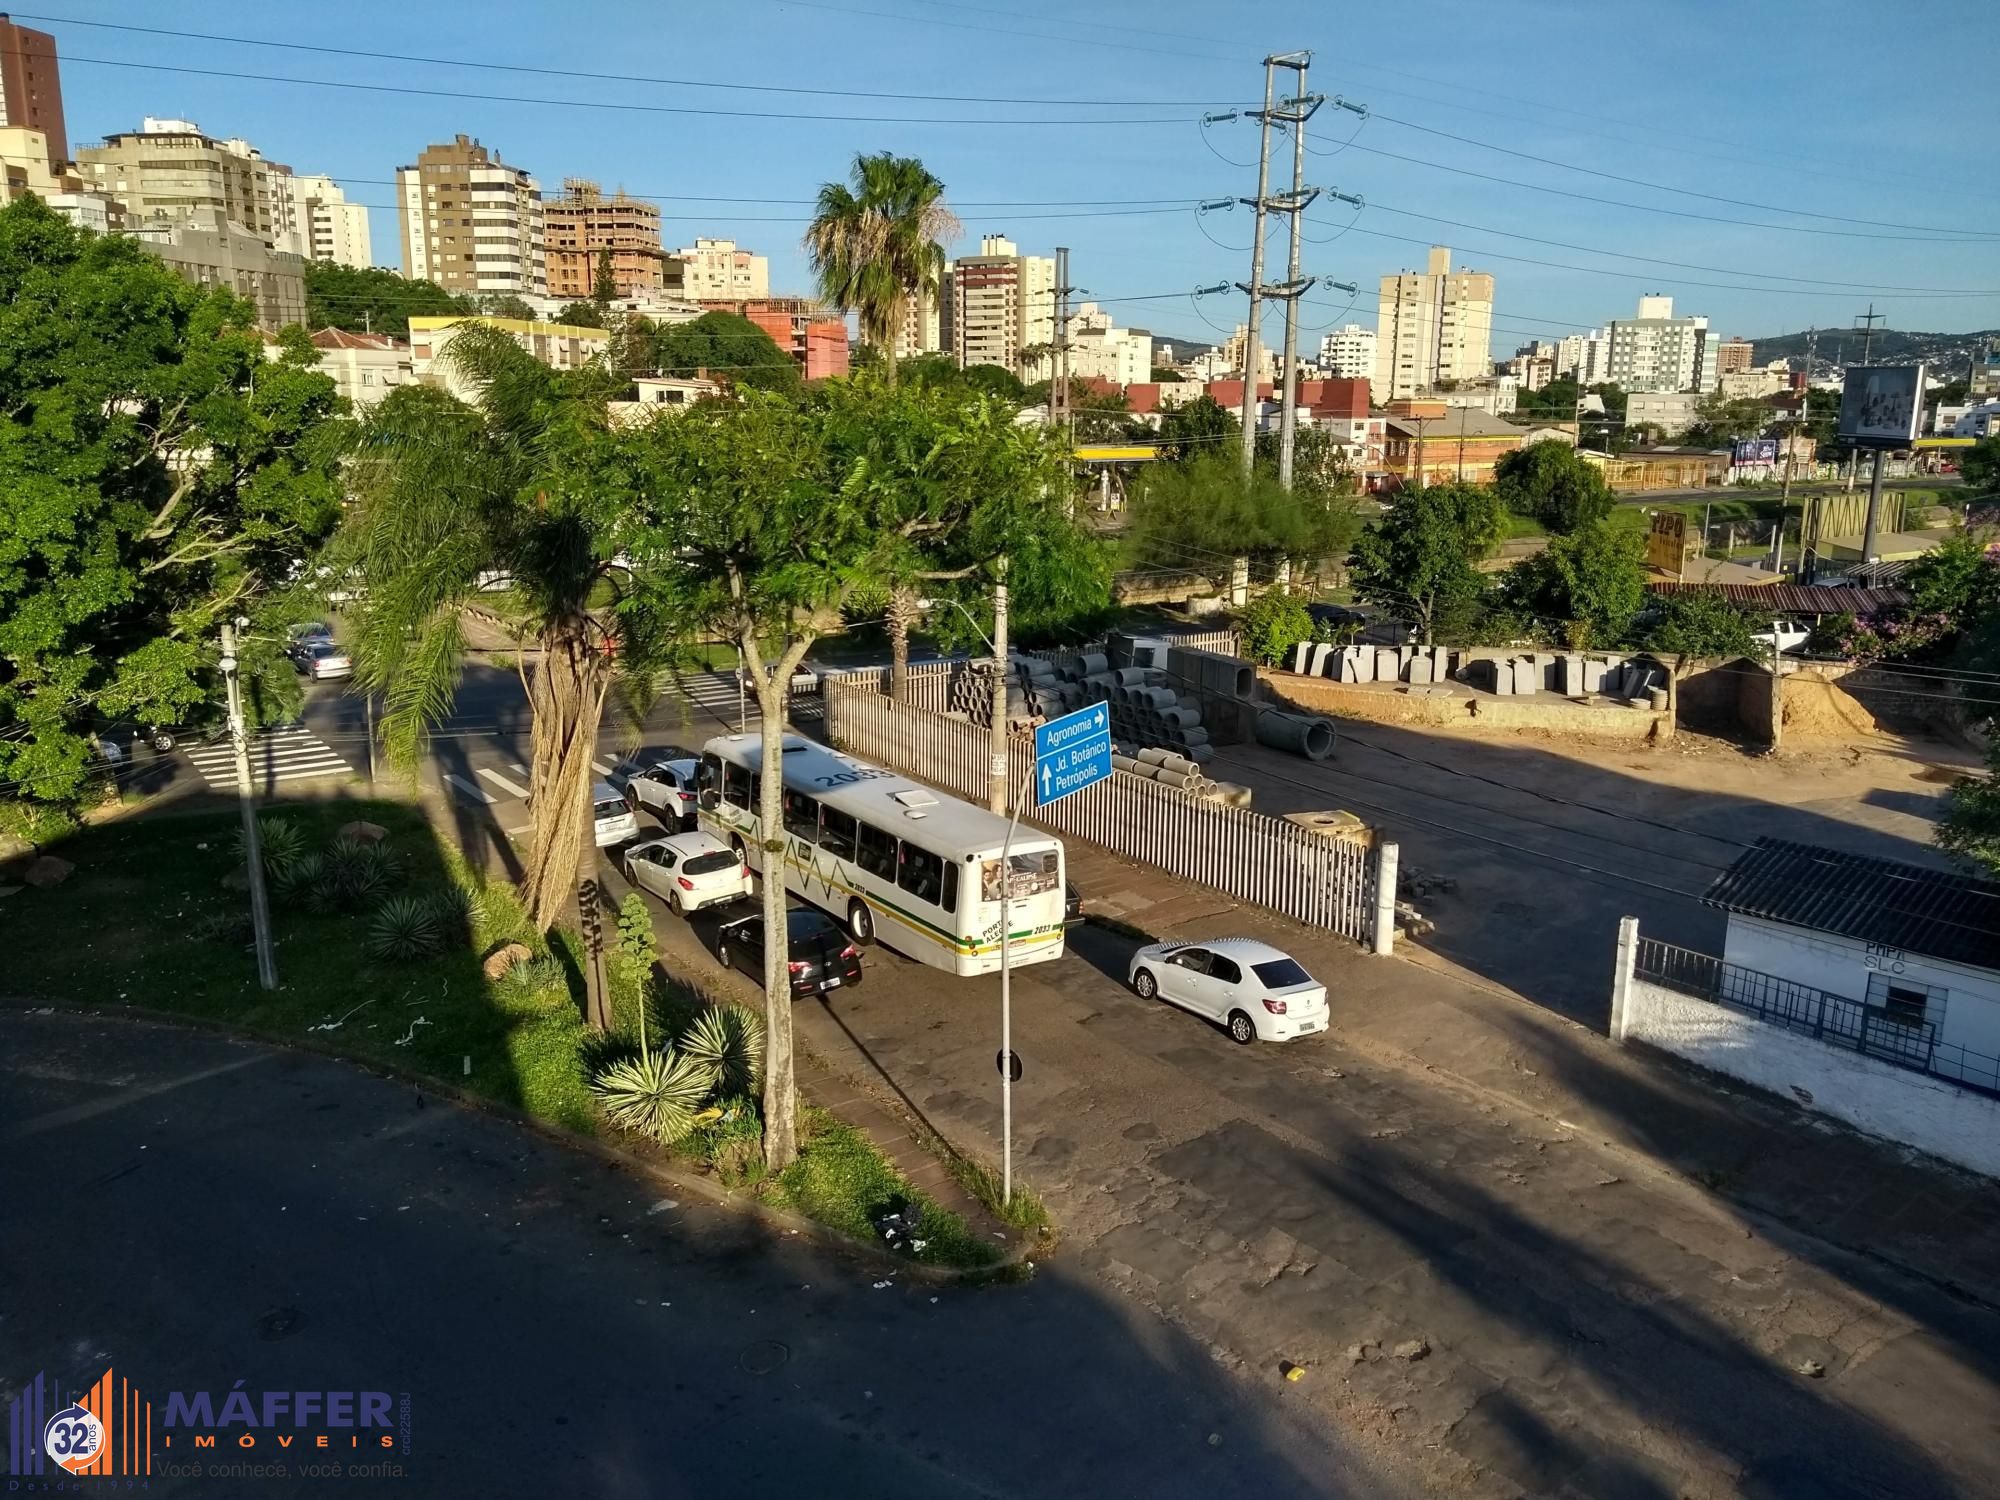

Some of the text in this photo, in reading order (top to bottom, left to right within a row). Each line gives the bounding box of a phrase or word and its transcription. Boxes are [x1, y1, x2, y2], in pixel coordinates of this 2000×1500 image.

[1047, 717, 1092, 747] Agronomia
[1055, 741, 1107, 773] Jd. Botânico
[814, 768, 897, 787] 2033
[1056, 763, 1098, 791] Petrópolis
[1034, 924, 1051, 935] 2033
[1864, 956, 1904, 974] SLC
